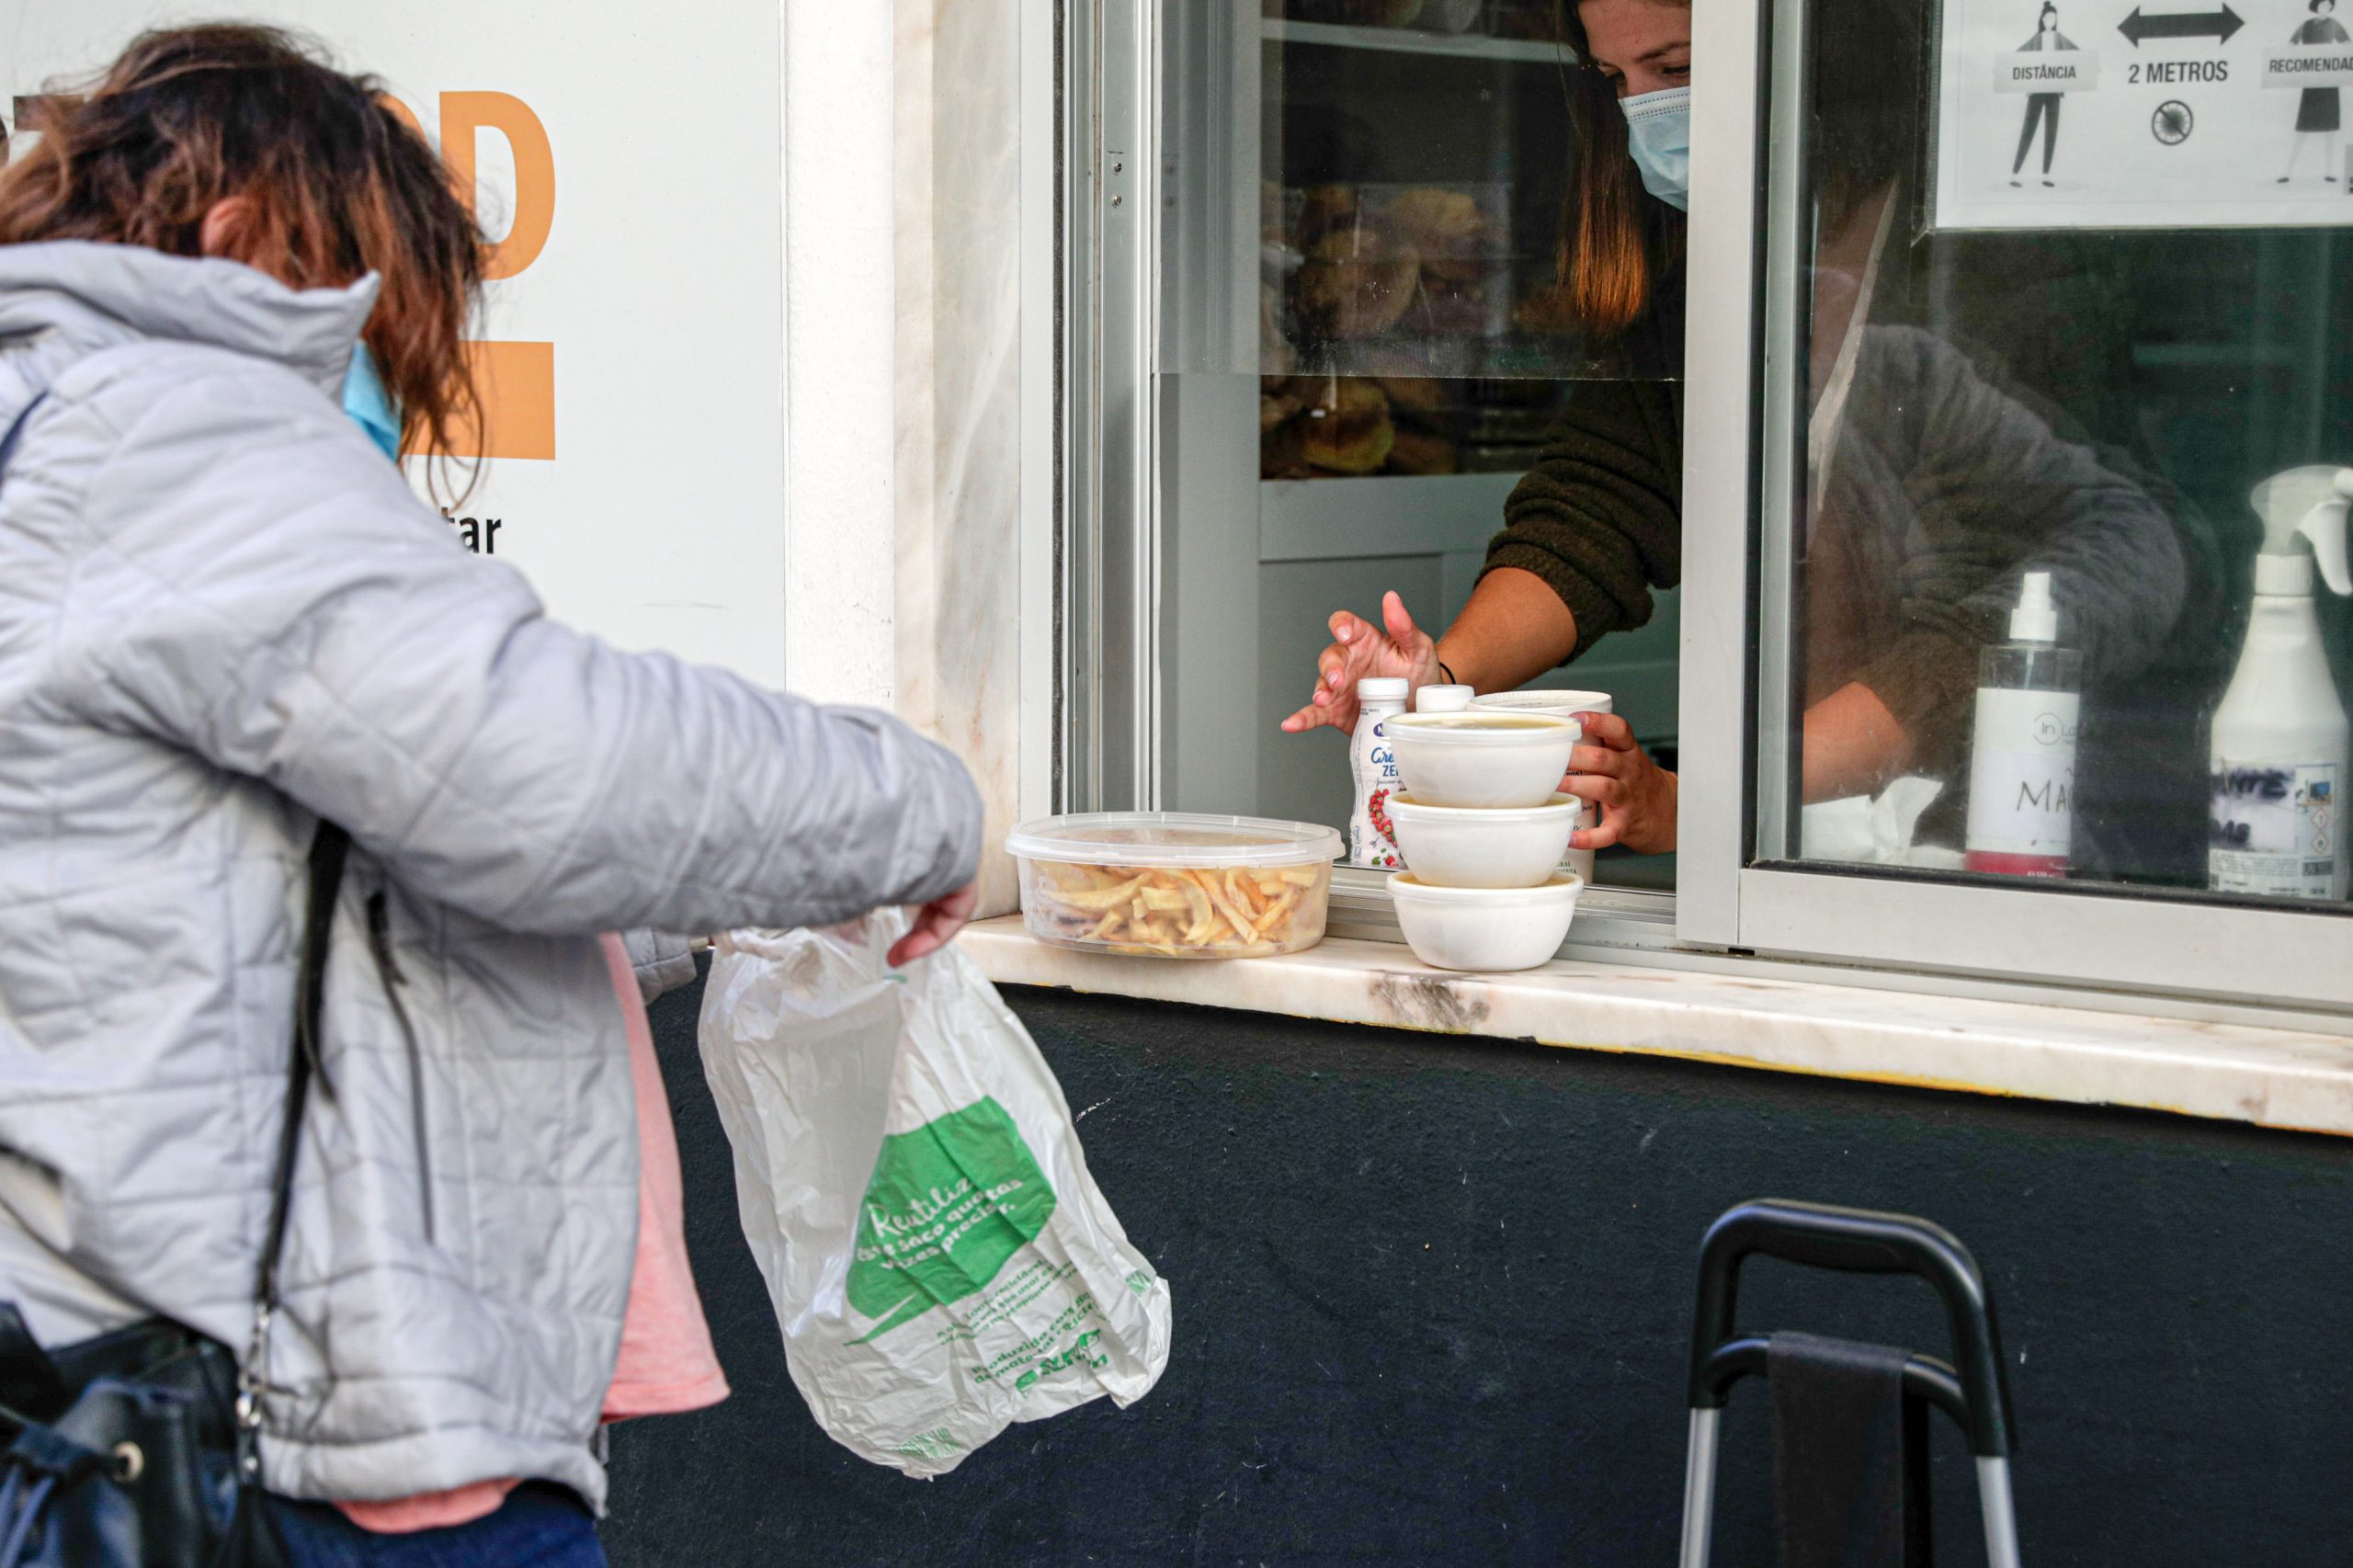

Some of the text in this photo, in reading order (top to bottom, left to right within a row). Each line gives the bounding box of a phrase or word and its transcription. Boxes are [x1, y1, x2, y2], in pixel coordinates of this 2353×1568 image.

[2013, 65, 2076, 81] DISTÂNCIA
[2128, 61, 2228, 84] 2 METROS
[1370, 746, 1394, 764] Cre
[897, 1223, 945, 1252] saco
